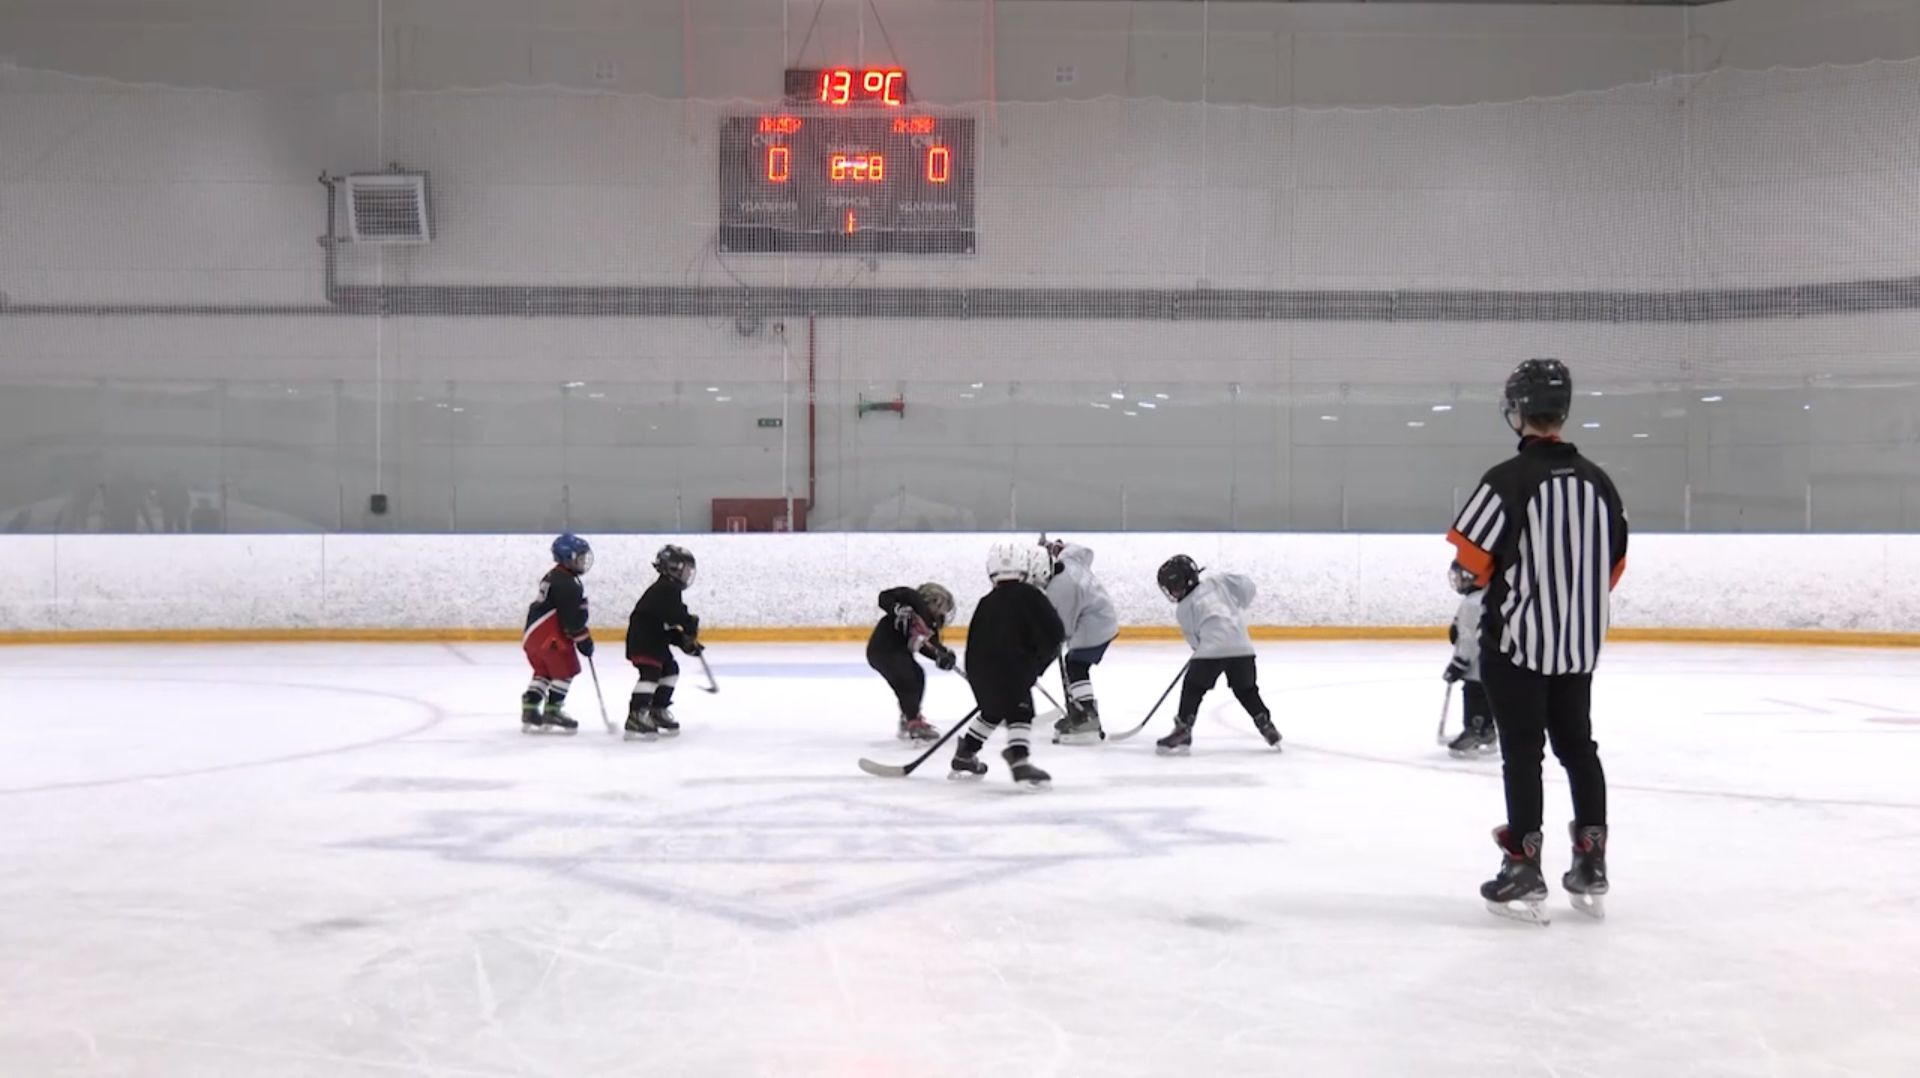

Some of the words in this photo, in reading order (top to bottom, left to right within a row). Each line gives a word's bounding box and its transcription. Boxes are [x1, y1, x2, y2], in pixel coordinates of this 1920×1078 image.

[821, 70, 851, 105] 13
[768, 147, 789, 181] 0
[928, 147, 949, 182] 0
